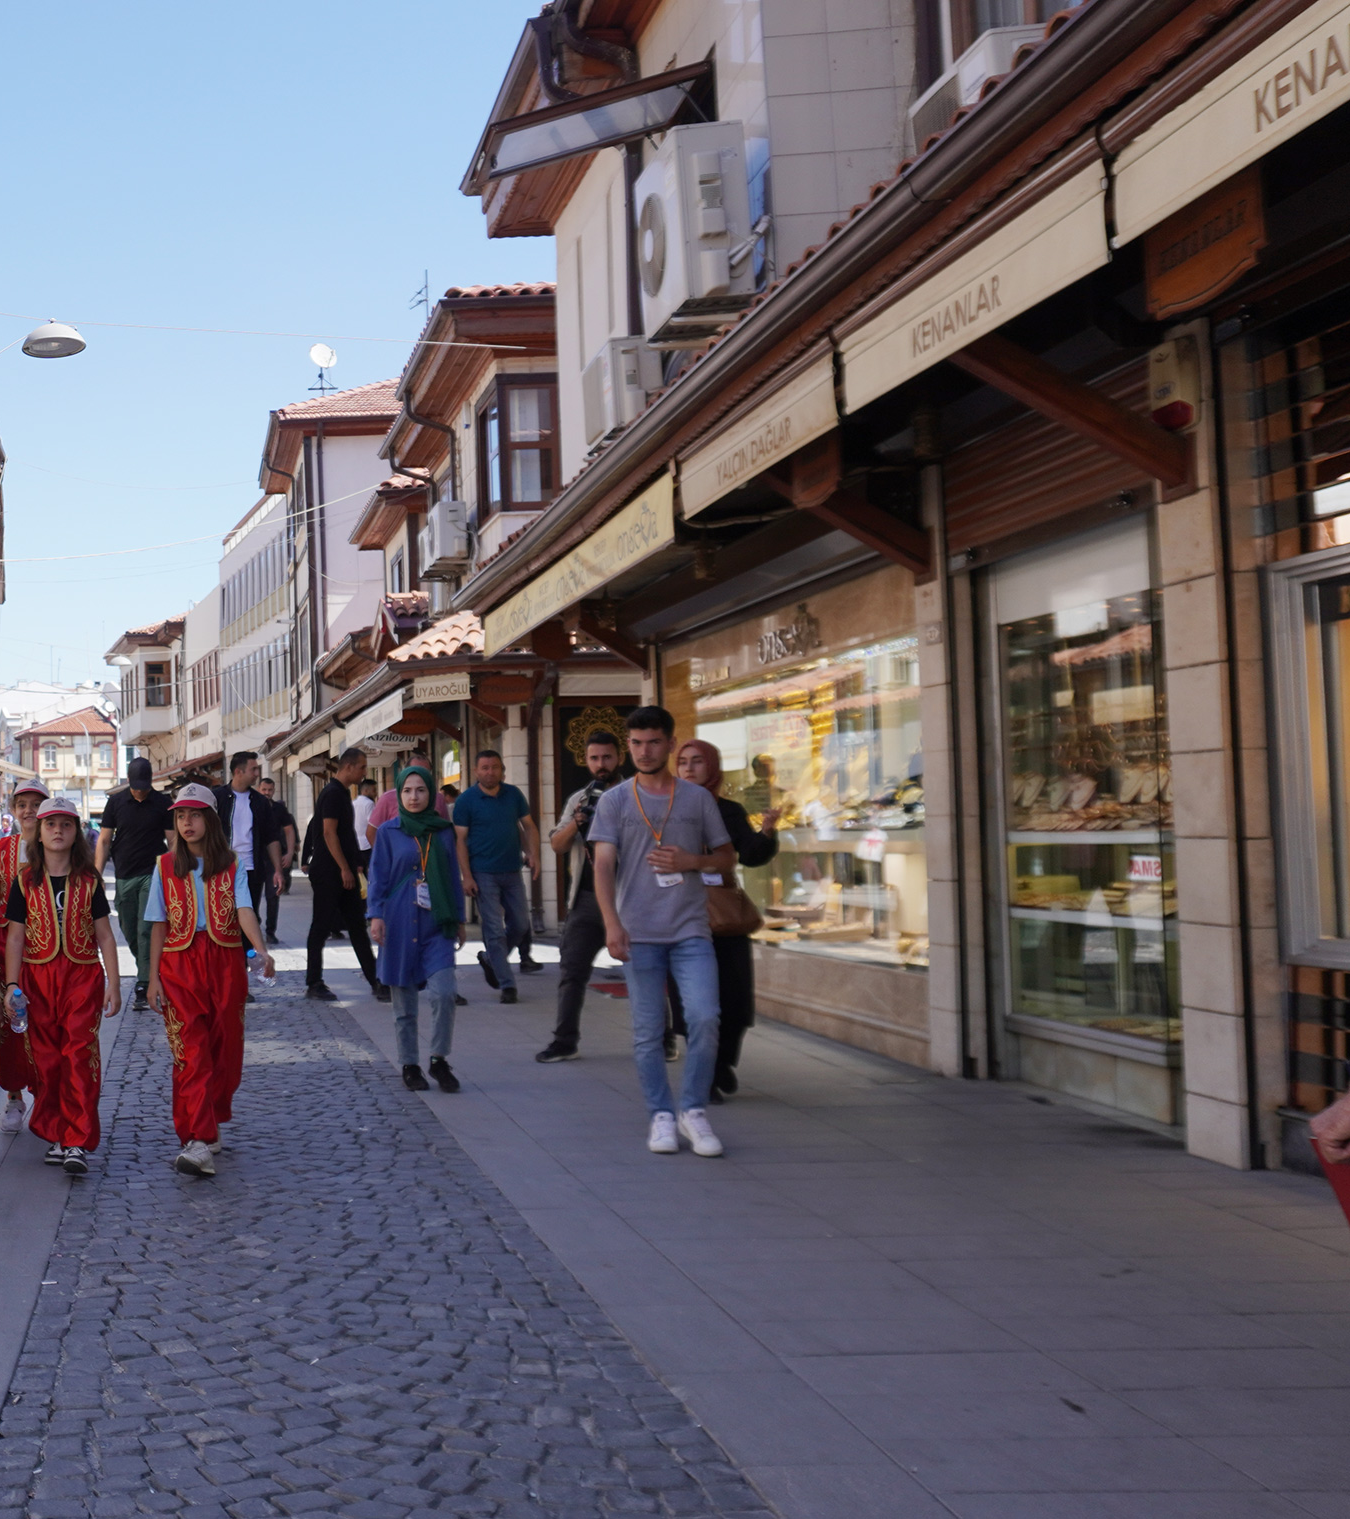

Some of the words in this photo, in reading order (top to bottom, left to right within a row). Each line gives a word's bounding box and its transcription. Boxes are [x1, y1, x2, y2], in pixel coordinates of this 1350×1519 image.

[1253, 24, 1350, 133] KENA
[912, 274, 1002, 358] KENANLAR
[716, 444, 749, 487] YALÇIN
[750, 416, 792, 465] DAĞLAR
[415, 682, 468, 699] UYAROĞLU
